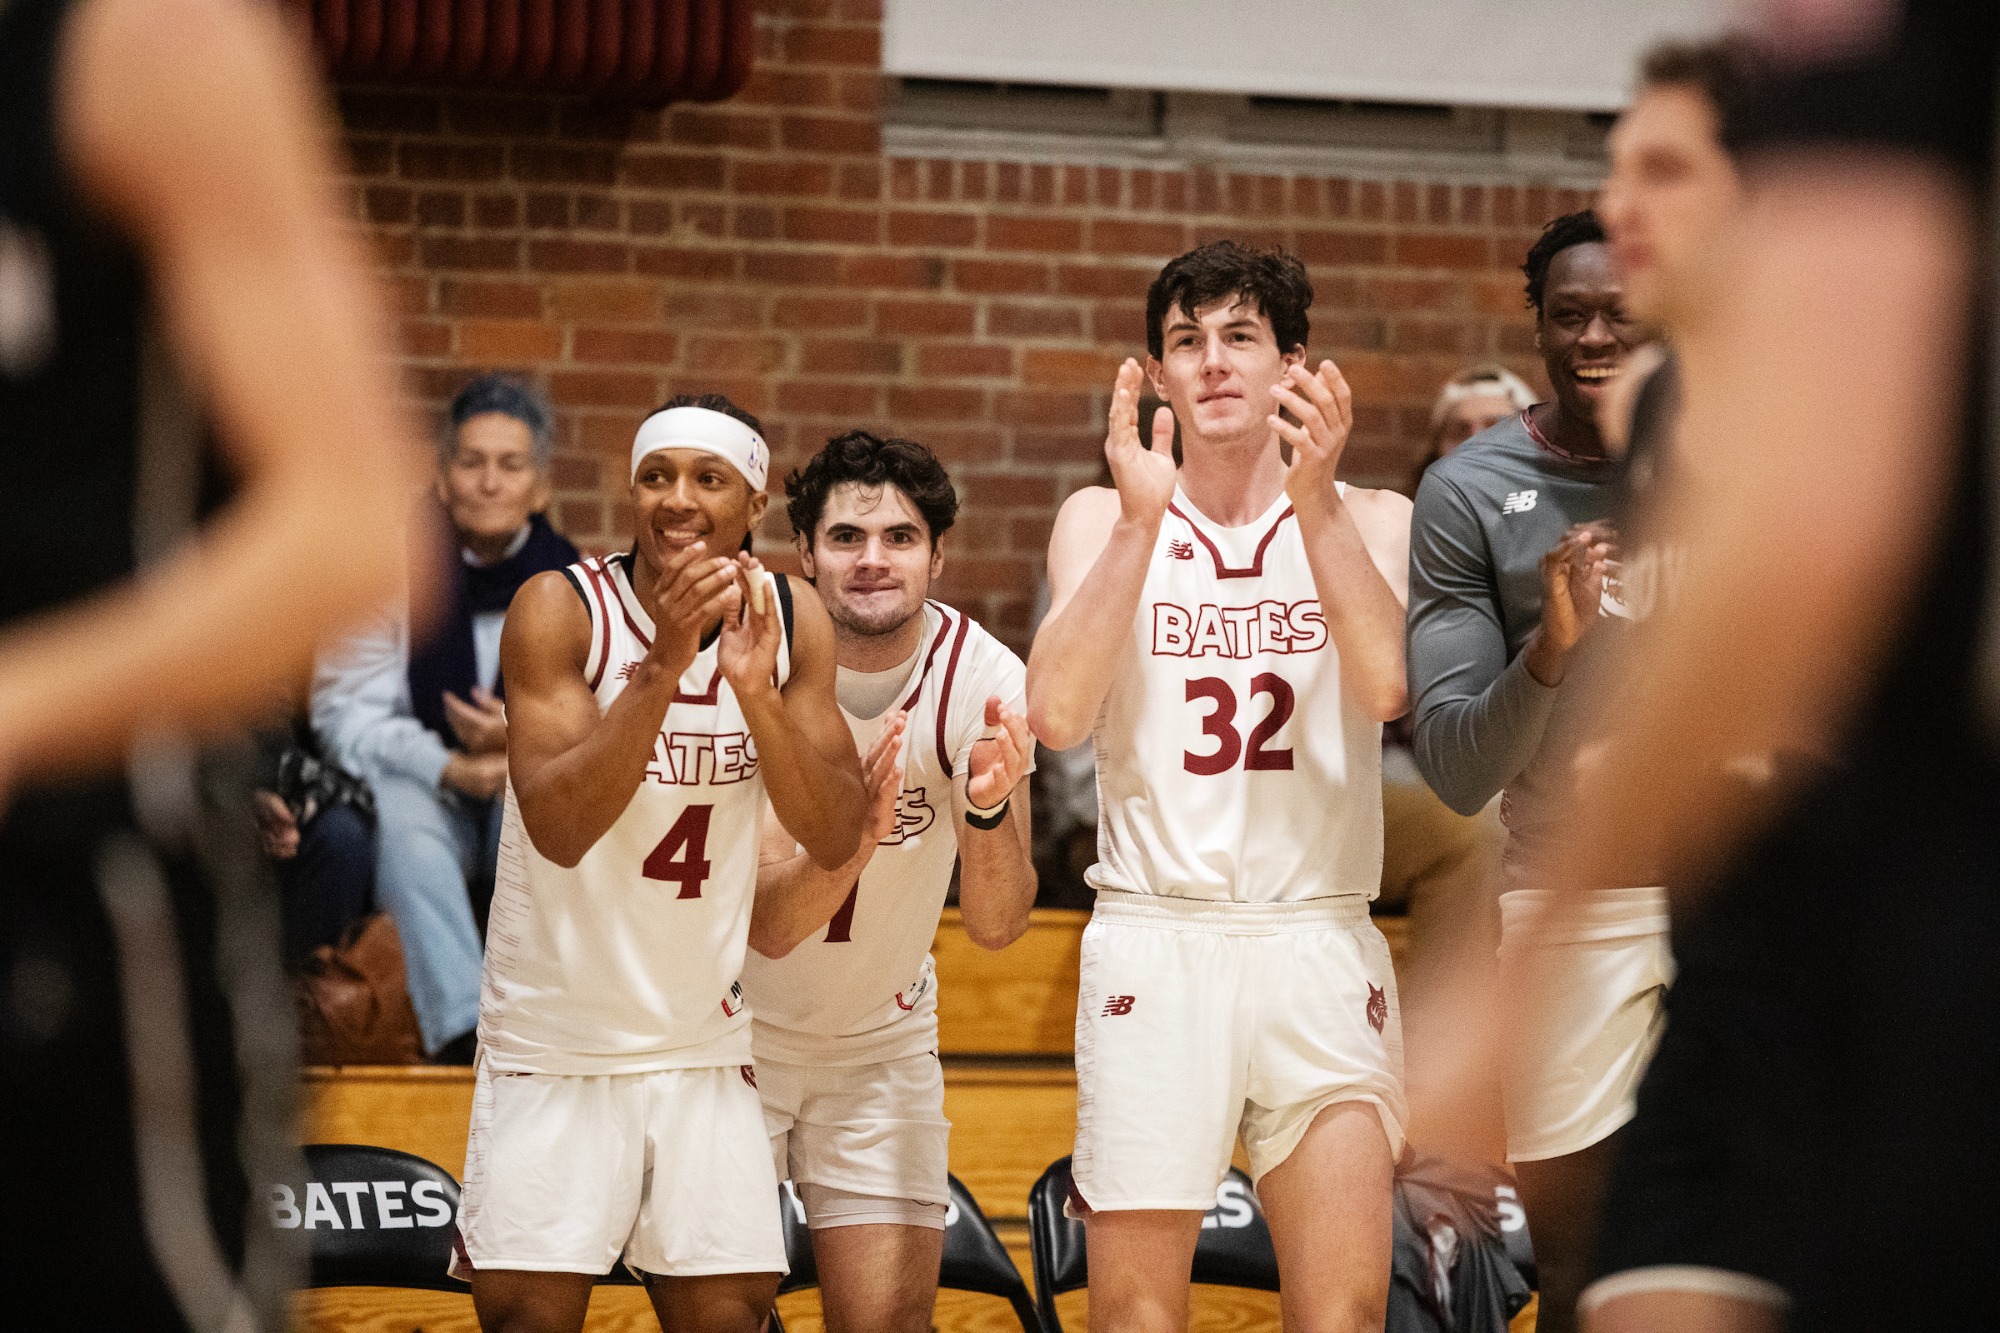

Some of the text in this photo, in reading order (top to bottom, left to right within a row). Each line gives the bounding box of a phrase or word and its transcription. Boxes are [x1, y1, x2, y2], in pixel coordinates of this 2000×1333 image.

[1152, 600, 1329, 659] BATES
[1183, 672, 1295, 776] 32
[642, 804, 715, 900] 4
[268, 1179, 452, 1230] BATES
